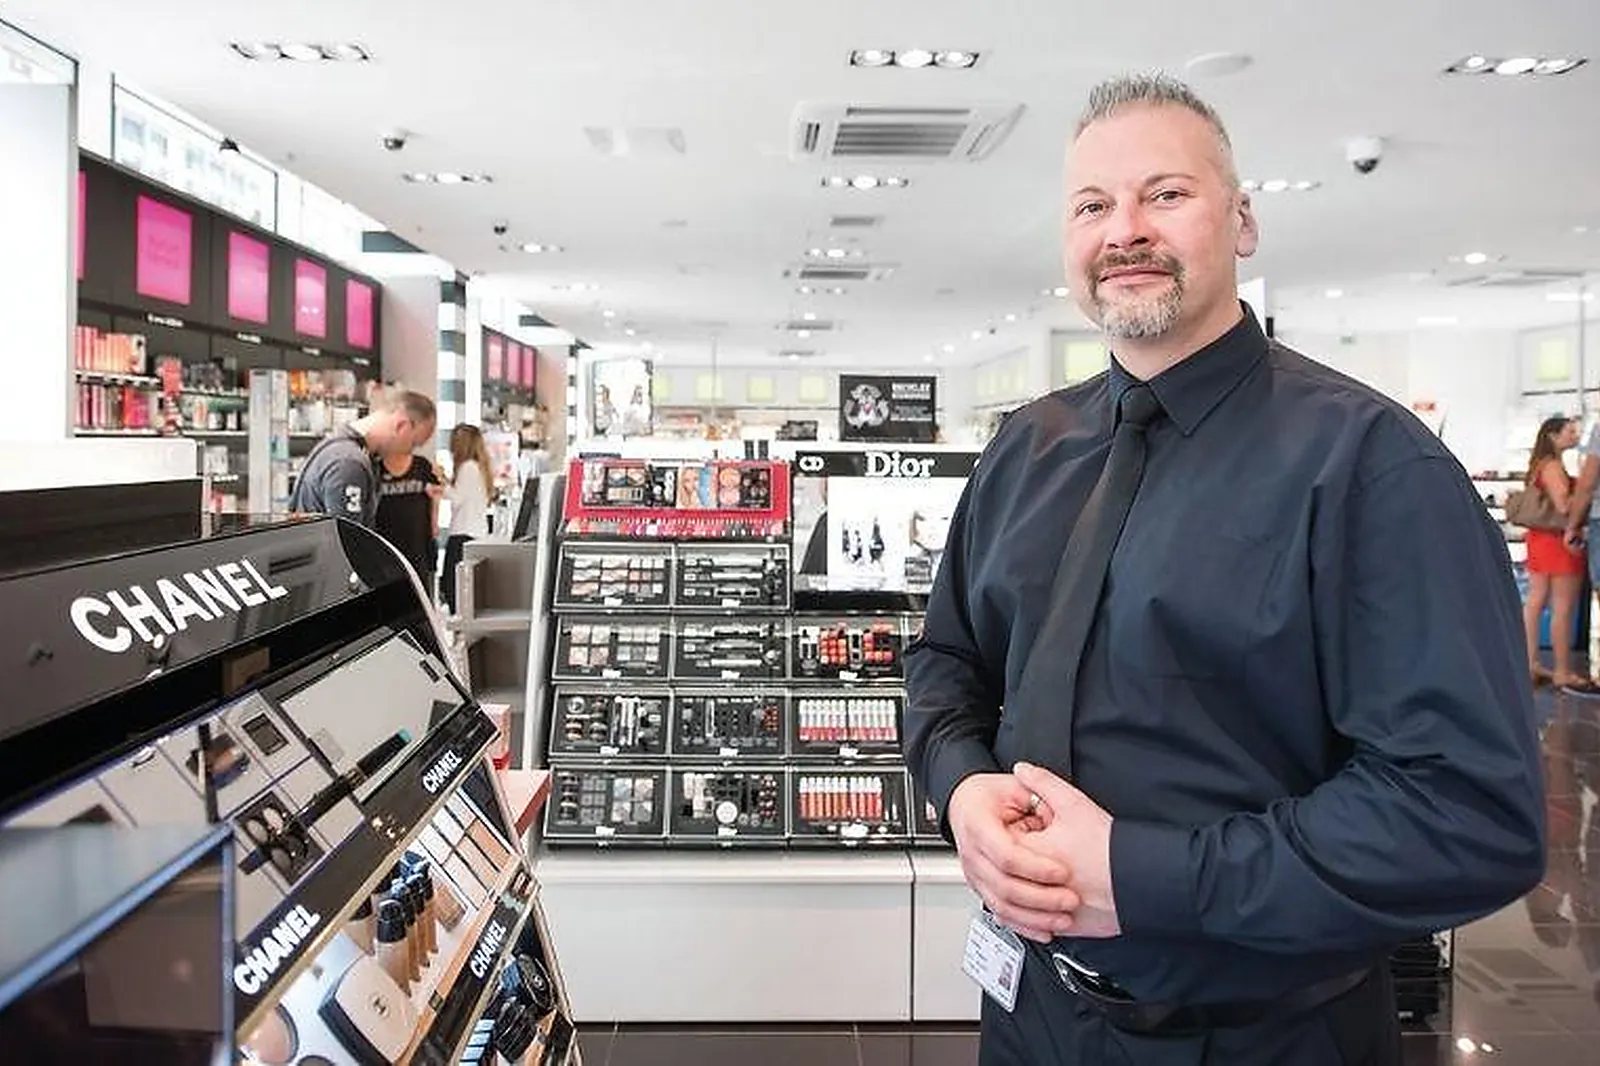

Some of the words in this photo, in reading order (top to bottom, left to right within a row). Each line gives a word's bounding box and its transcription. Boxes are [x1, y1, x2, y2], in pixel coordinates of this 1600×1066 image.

[865, 450, 936, 477] Dior
[70, 555, 289, 653] CHANEL
[422, 749, 463, 793] CHANEL
[233, 904, 321, 995] CHANEL
[470, 919, 507, 979] CHANEL
